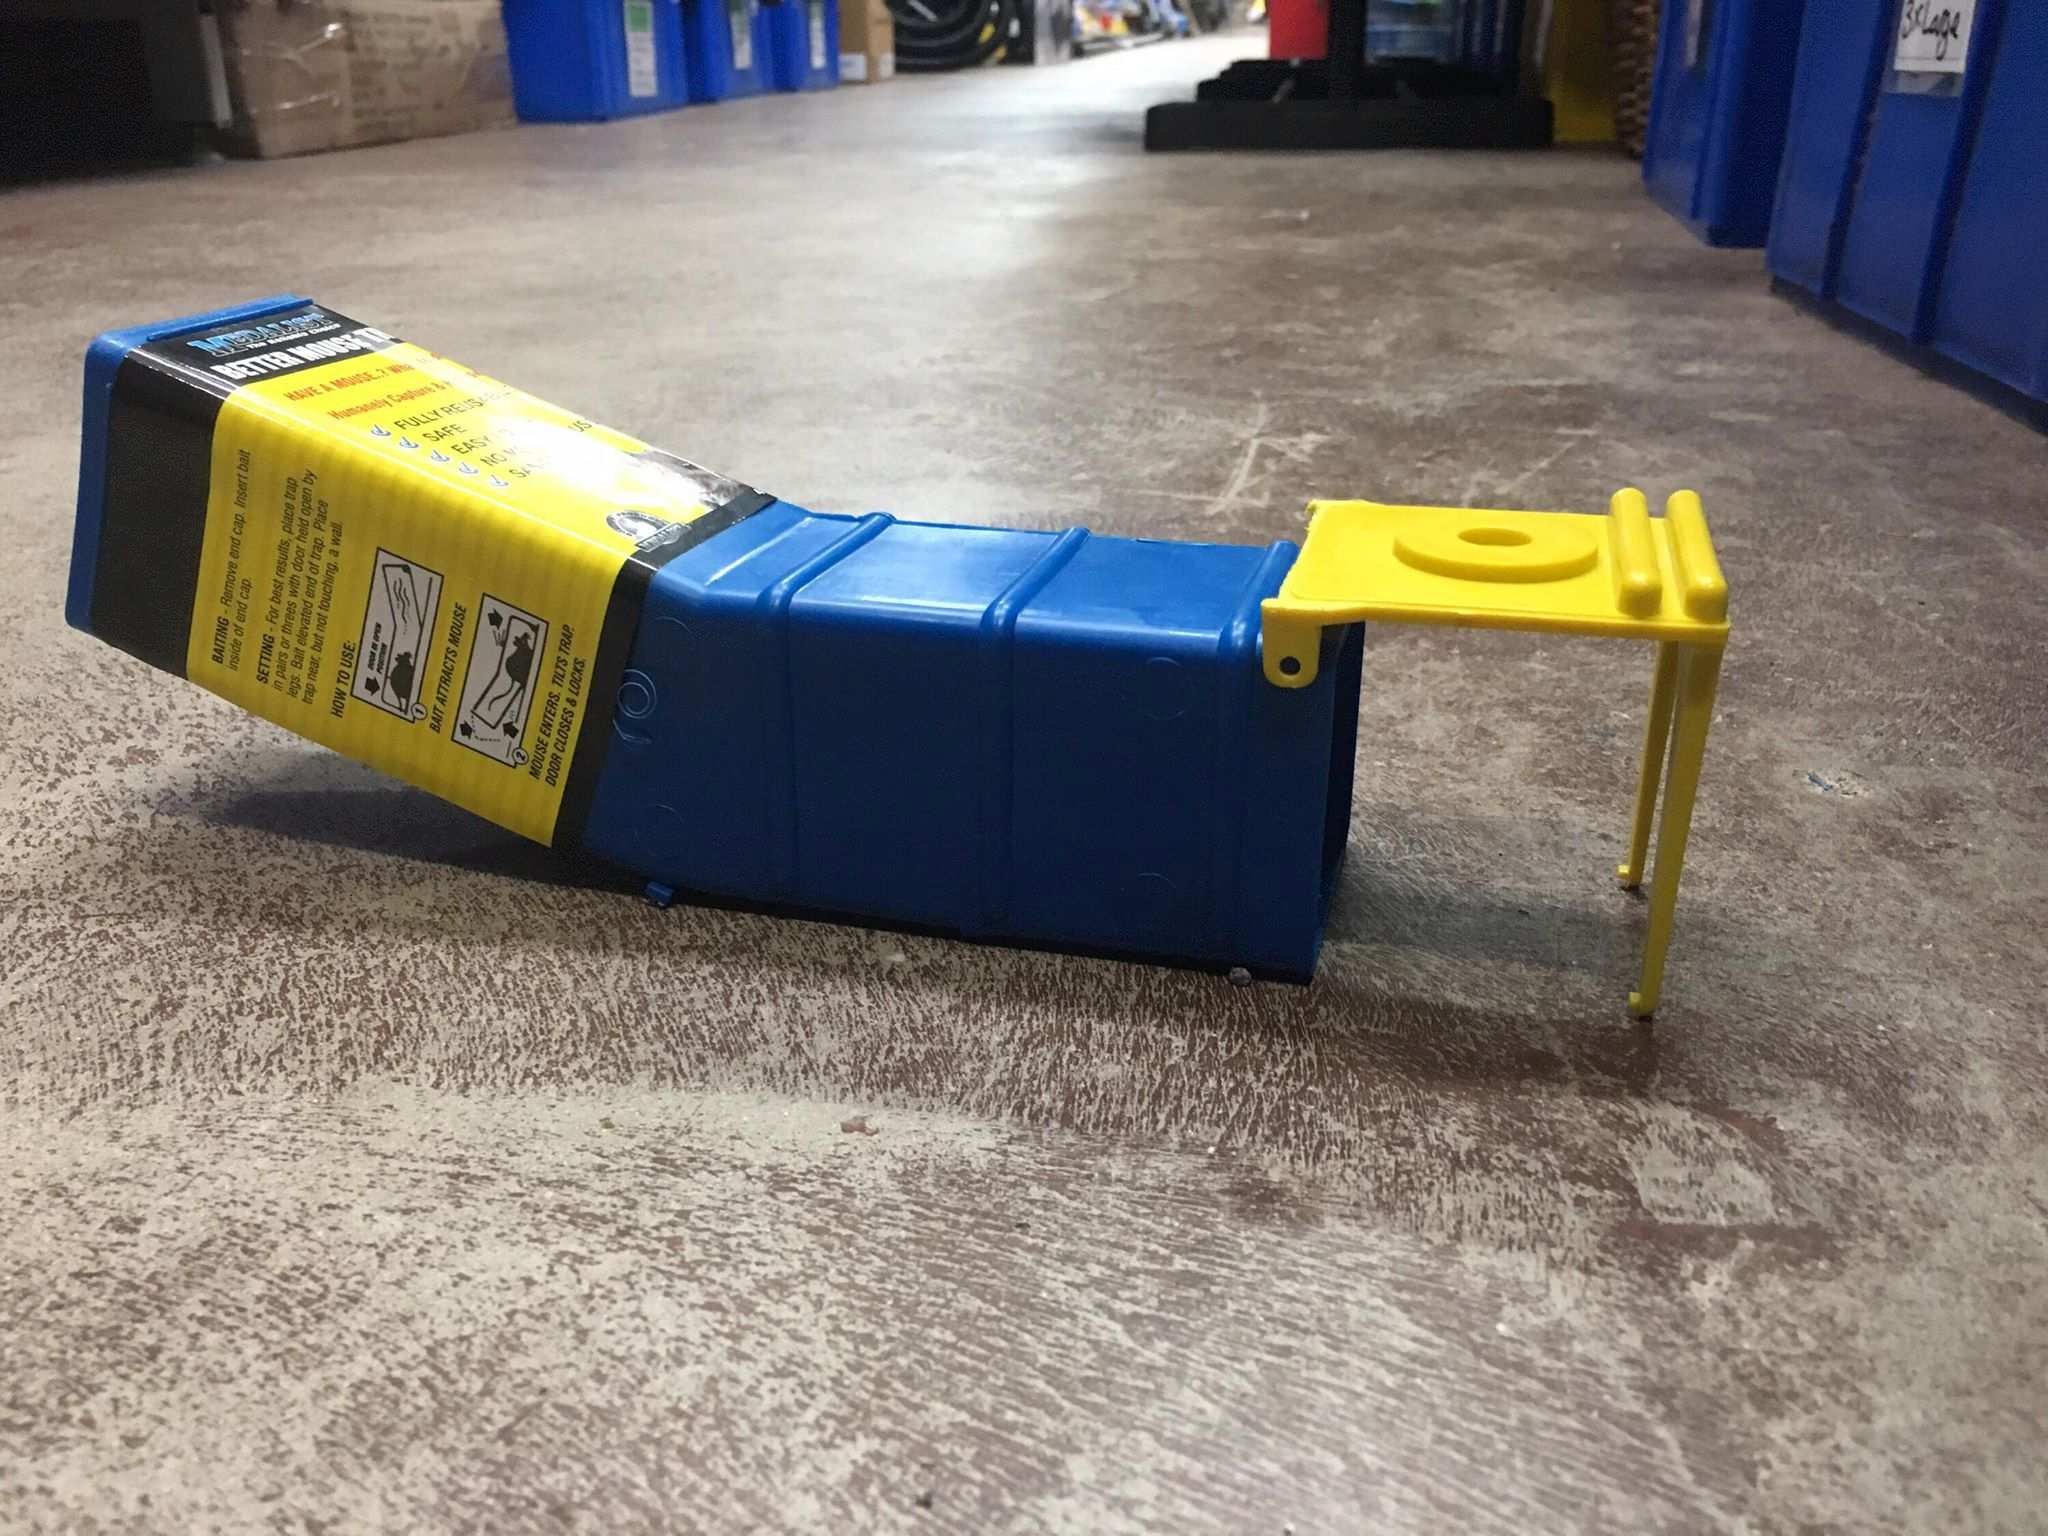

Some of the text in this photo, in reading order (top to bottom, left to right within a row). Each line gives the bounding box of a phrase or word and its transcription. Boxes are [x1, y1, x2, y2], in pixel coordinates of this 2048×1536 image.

[187, 312, 334, 357] MEDALIST
[210, 350, 305, 380] BETTER
[292, 334, 372, 362] MOUSE
[283, 386, 322, 402] HAVE
[320, 383, 335, 392] A
[327, 398, 393, 420] Humanely
[393, 390, 511, 430] FULLY REUSAB
[422, 423, 468, 442] SAFE
[450, 434, 491, 455] EASY
[237, 449, 251, 472] bait
[480, 451, 507, 466] NO
[234, 473, 248, 508] Insert
[284, 477, 298, 501] trap
[232, 512, 247, 535] cap.
[281, 502, 295, 535] place
[313, 500, 328, 532] Place
[229, 536, 242, 560] end
[329, 547, 340, 558] a
[272, 469, 318, 692] in pairs or threes with door held open by
[308, 560, 320, 576] of
[220, 561, 239, 608] Remove
[270, 578, 284, 605] best
[305, 576, 318, 599] end
[235, 601, 248, 623] end
[266, 605, 279, 624] For
[296, 600, 313, 646] elevated
[315, 613, 328, 633] not
[211, 615, 230, 665] BAITING
[233, 623, 244, 637] of
[226, 639, 242, 671] inside
[311, 633, 323, 653] but
[256, 633, 275, 684] SETTING
[290, 645, 305, 670] Bait
[429, 602, 467, 734] BAIT ATTRACTS MOUSE
[330, 640, 357, 719] HOW TO USE:
[302, 682, 317, 705] trap
[528, 737, 546, 780] MOUSE
[551, 656, 568, 689] TILTS
[553, 708, 575, 752] CLOSES
[545, 751, 562, 787] DOOR
